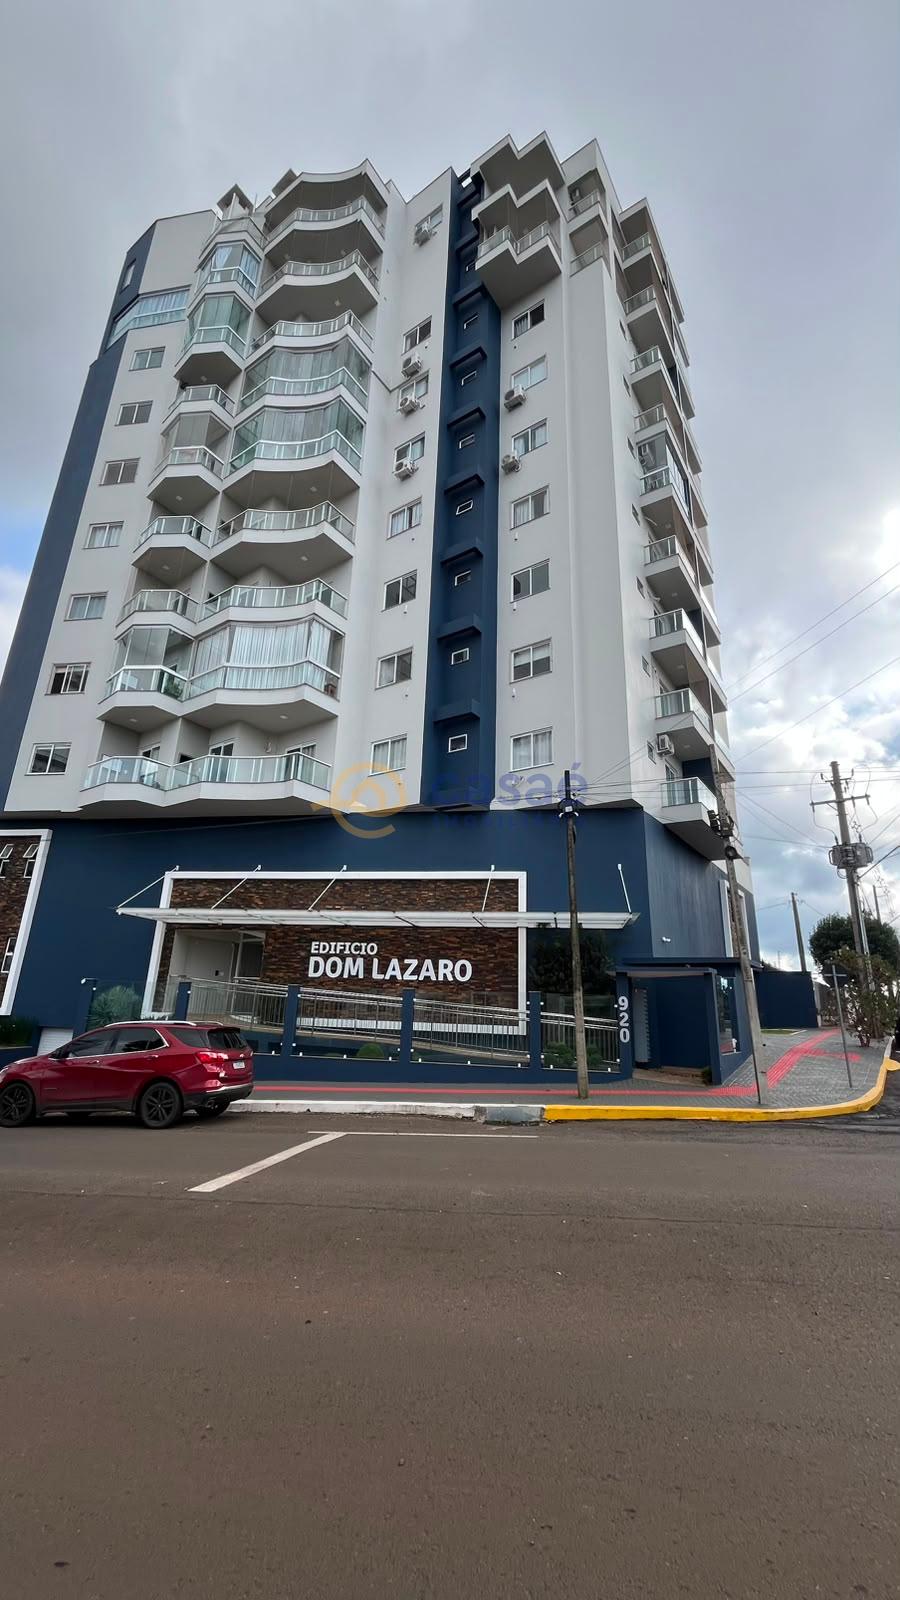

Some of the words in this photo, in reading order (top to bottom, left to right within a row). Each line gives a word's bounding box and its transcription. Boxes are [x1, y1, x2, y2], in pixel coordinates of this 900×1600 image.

[310, 941, 378, 956] EDIFICIO
[308, 956, 364, 979] DOM
[371, 957, 473, 982] LAZARO
[617, 995, 631, 1044] 920
